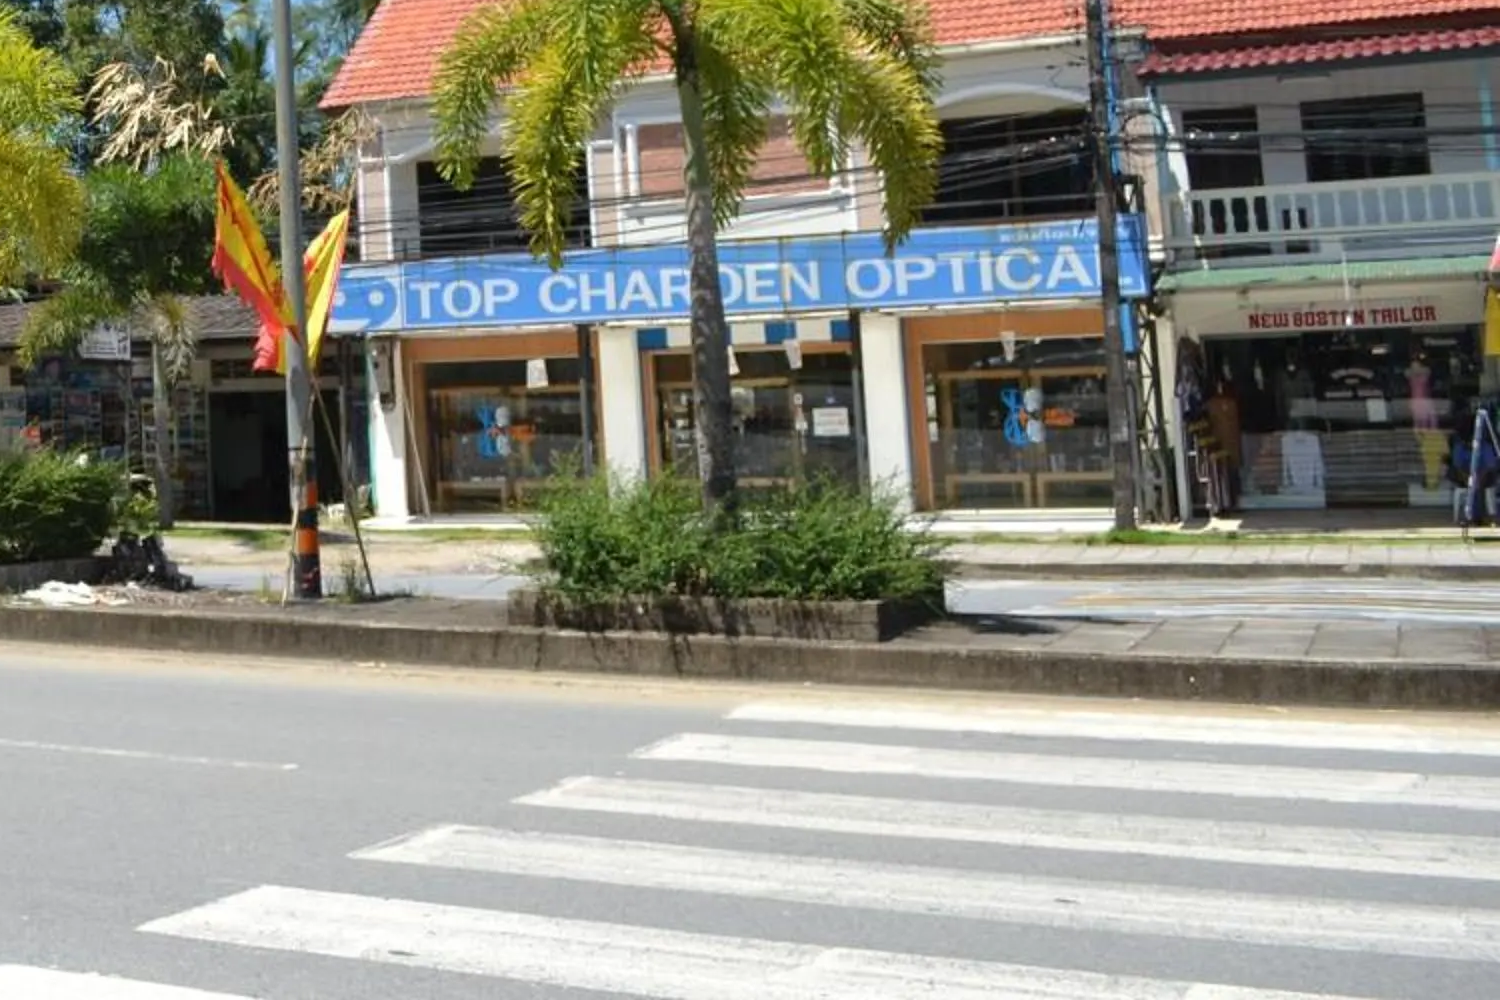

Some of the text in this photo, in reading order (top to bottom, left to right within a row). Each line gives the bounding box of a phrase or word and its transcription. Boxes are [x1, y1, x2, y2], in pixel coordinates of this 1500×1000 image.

[409, 278, 519, 320] TOP
[1248, 313, 1289, 329] NEW
[1370, 305, 1437, 326] TAILOR
